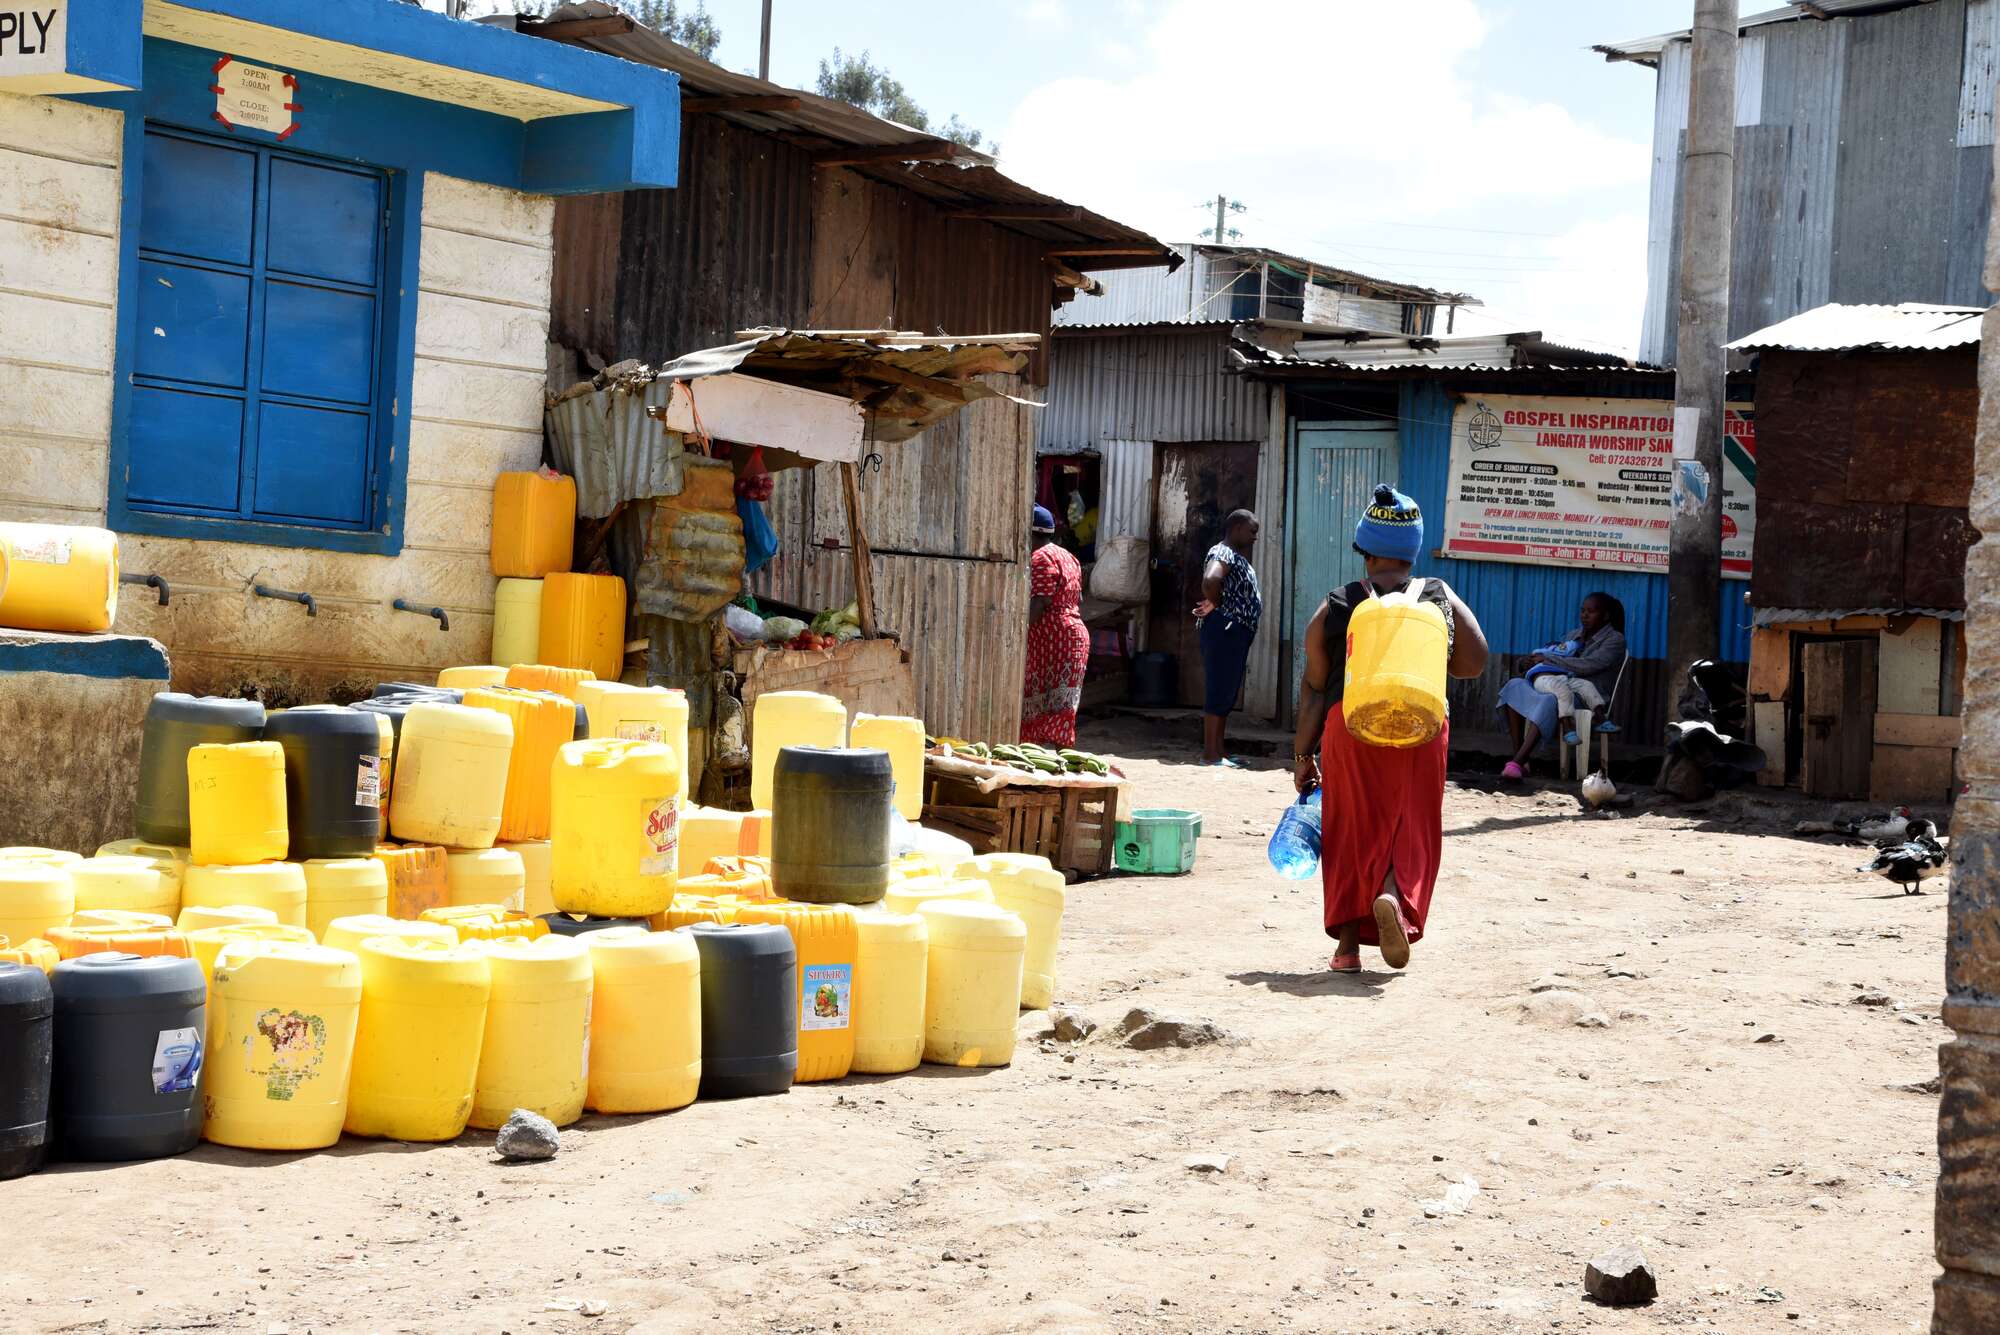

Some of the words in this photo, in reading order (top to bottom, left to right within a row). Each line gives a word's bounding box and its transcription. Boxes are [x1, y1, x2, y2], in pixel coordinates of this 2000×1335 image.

[244, 68, 269, 80] OPEN:
[240, 100, 270, 112] CLOSE:
[1504, 410, 1566, 428] GOSPEL
[1536, 432, 1586, 449] LANGATA
[1589, 434, 1646, 452] WORSHIP
[1648, 438, 1673, 453] SAN
[1589, 454, 1606, 465] Cell:
[1608, 454, 1664, 467] 0724326724
[1474, 462, 1494, 470] ORDER
[1494, 463, 1502, 471] OF
[1503, 464, 1528, 473] SUNDAY
[1529, 465, 1555, 475] SERVICE
[1462, 473, 1501, 484] Intercessory
[1502, 476, 1528, 485] prayers
[1534, 478, 1558, 486] 9:00am
[1622, 471, 1657, 481] WEEKDAYS
[1461, 485, 1476, 494] Bible
[1476, 486, 1494, 496] Study
[1528, 490, 1554, 498] 10:45am
[1598, 481, 1630, 492] Wednesday
[1634, 484, 1660, 493] Midweek
[1661, 486, 1672, 494] Ser
[1460, 494, 1475, 502] Main
[1476, 494, 1500, 504] Service
[1504, 496, 1530, 506] 10:45am
[1597, 494, 1622, 504] Saturday
[1625, 496, 1644, 505] Praise
[1484, 508, 1501, 518] OPEN
[1502, 509, 1514, 519] AIR
[1514, 510, 1536, 520] LUNCH
[1536, 511, 1562, 521] HOURS:
[1563, 512, 1594, 524] MONDAY
[1601, 515, 1644, 528] WEDNESDAY
[1649, 520, 1670, 529] FRIDA
[1484, 522, 1490, 530] To
[1491, 524, 1516, 532] reconcile
[1516, 524, 1527, 532] and
[1528, 526, 1549, 534] restore
[1566, 528, 1574, 536] for
[1575, 529, 1592, 538] Christ
[1478, 532, 1488, 540] The
[1489, 532, 1502, 540] Lord
[1503, 533, 1513, 541] will
[1514, 534, 1529, 542] make
[1530, 535, 1551, 544] nations
[1563, 538, 1596, 548] inheritance
[1597, 540, 1608, 548] and
[1608, 540, 1618, 549] the
[1618, 541, 1632, 550] ends
[1640, 542, 1651, 551] the
[1524, 544, 1553, 556] Theme:
[1554, 546, 1575, 559] John
[1576, 548, 1591, 560] 1:16
[1594, 549, 1621, 562] GRACE
[1622, 552, 1645, 564] UPON
[1646, 554, 1669, 566] GRAC
